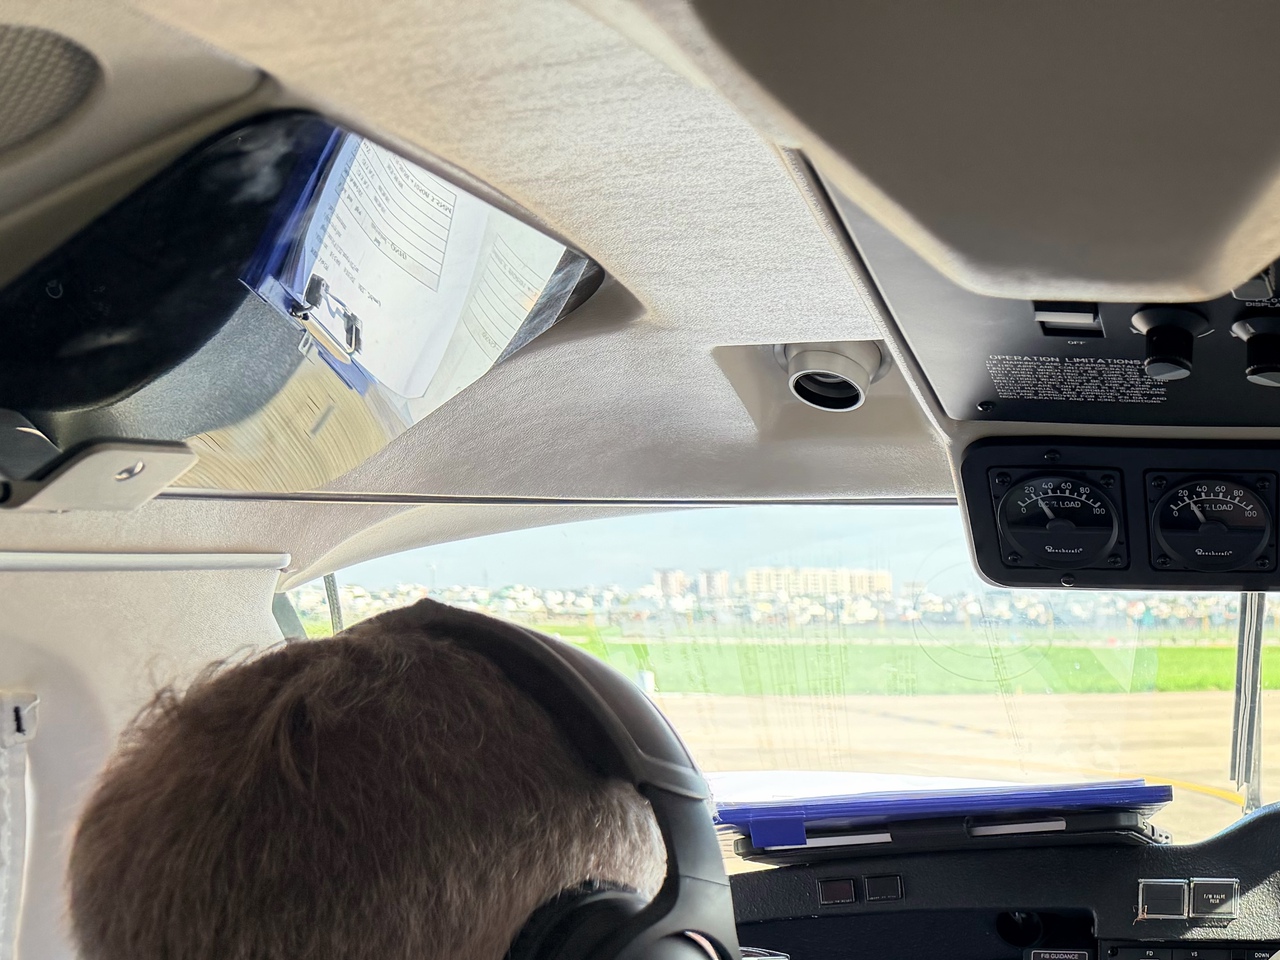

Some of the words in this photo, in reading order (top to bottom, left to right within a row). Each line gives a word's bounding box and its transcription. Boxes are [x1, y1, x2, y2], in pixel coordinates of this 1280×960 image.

[989, 354, 1060, 363] OPERATION
[1065, 356, 1142, 366] LIMITATIONS
[1024, 486, 1034, 494] 20
[1042, 482, 1053, 490] 40
[1061, 482, 1072, 490] 60
[1079, 486, 1090, 494] 80
[1059, 500, 1081, 508] LOAD
[1211, 503, 1234, 511] LOAD
[1092, 507, 1106, 515] 100
